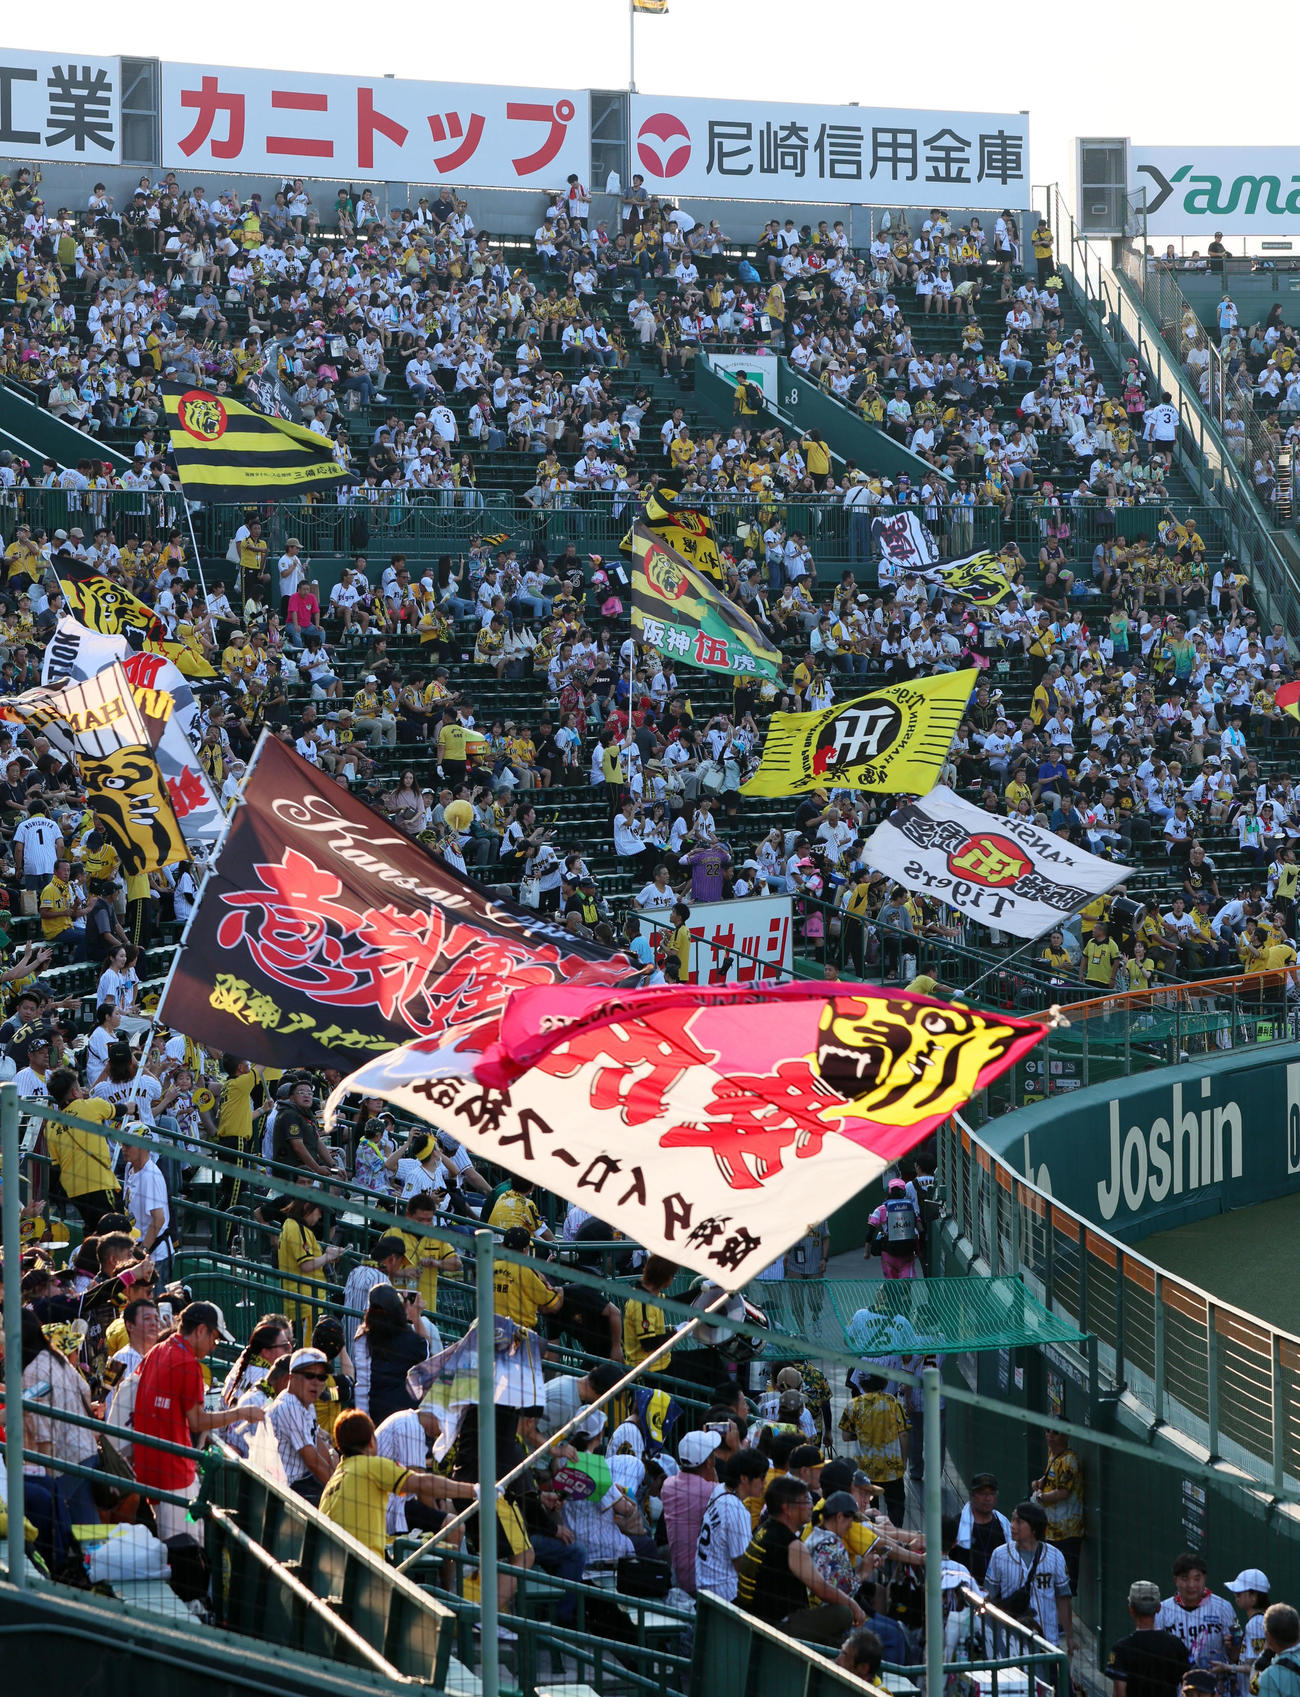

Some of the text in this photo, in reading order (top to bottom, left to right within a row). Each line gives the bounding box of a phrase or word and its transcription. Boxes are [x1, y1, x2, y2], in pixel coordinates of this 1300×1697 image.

[177, 75, 576, 177] カニトップ
[705, 119, 1024, 186] 尼崎信用金庫
[1164, 413, 1172, 425] 3
[36, 829, 44, 846] 1
[271, 794, 473, 910] Kansai
[705, 863, 721, 878] 22
[1097, 1076, 1243, 1220] Joshin
